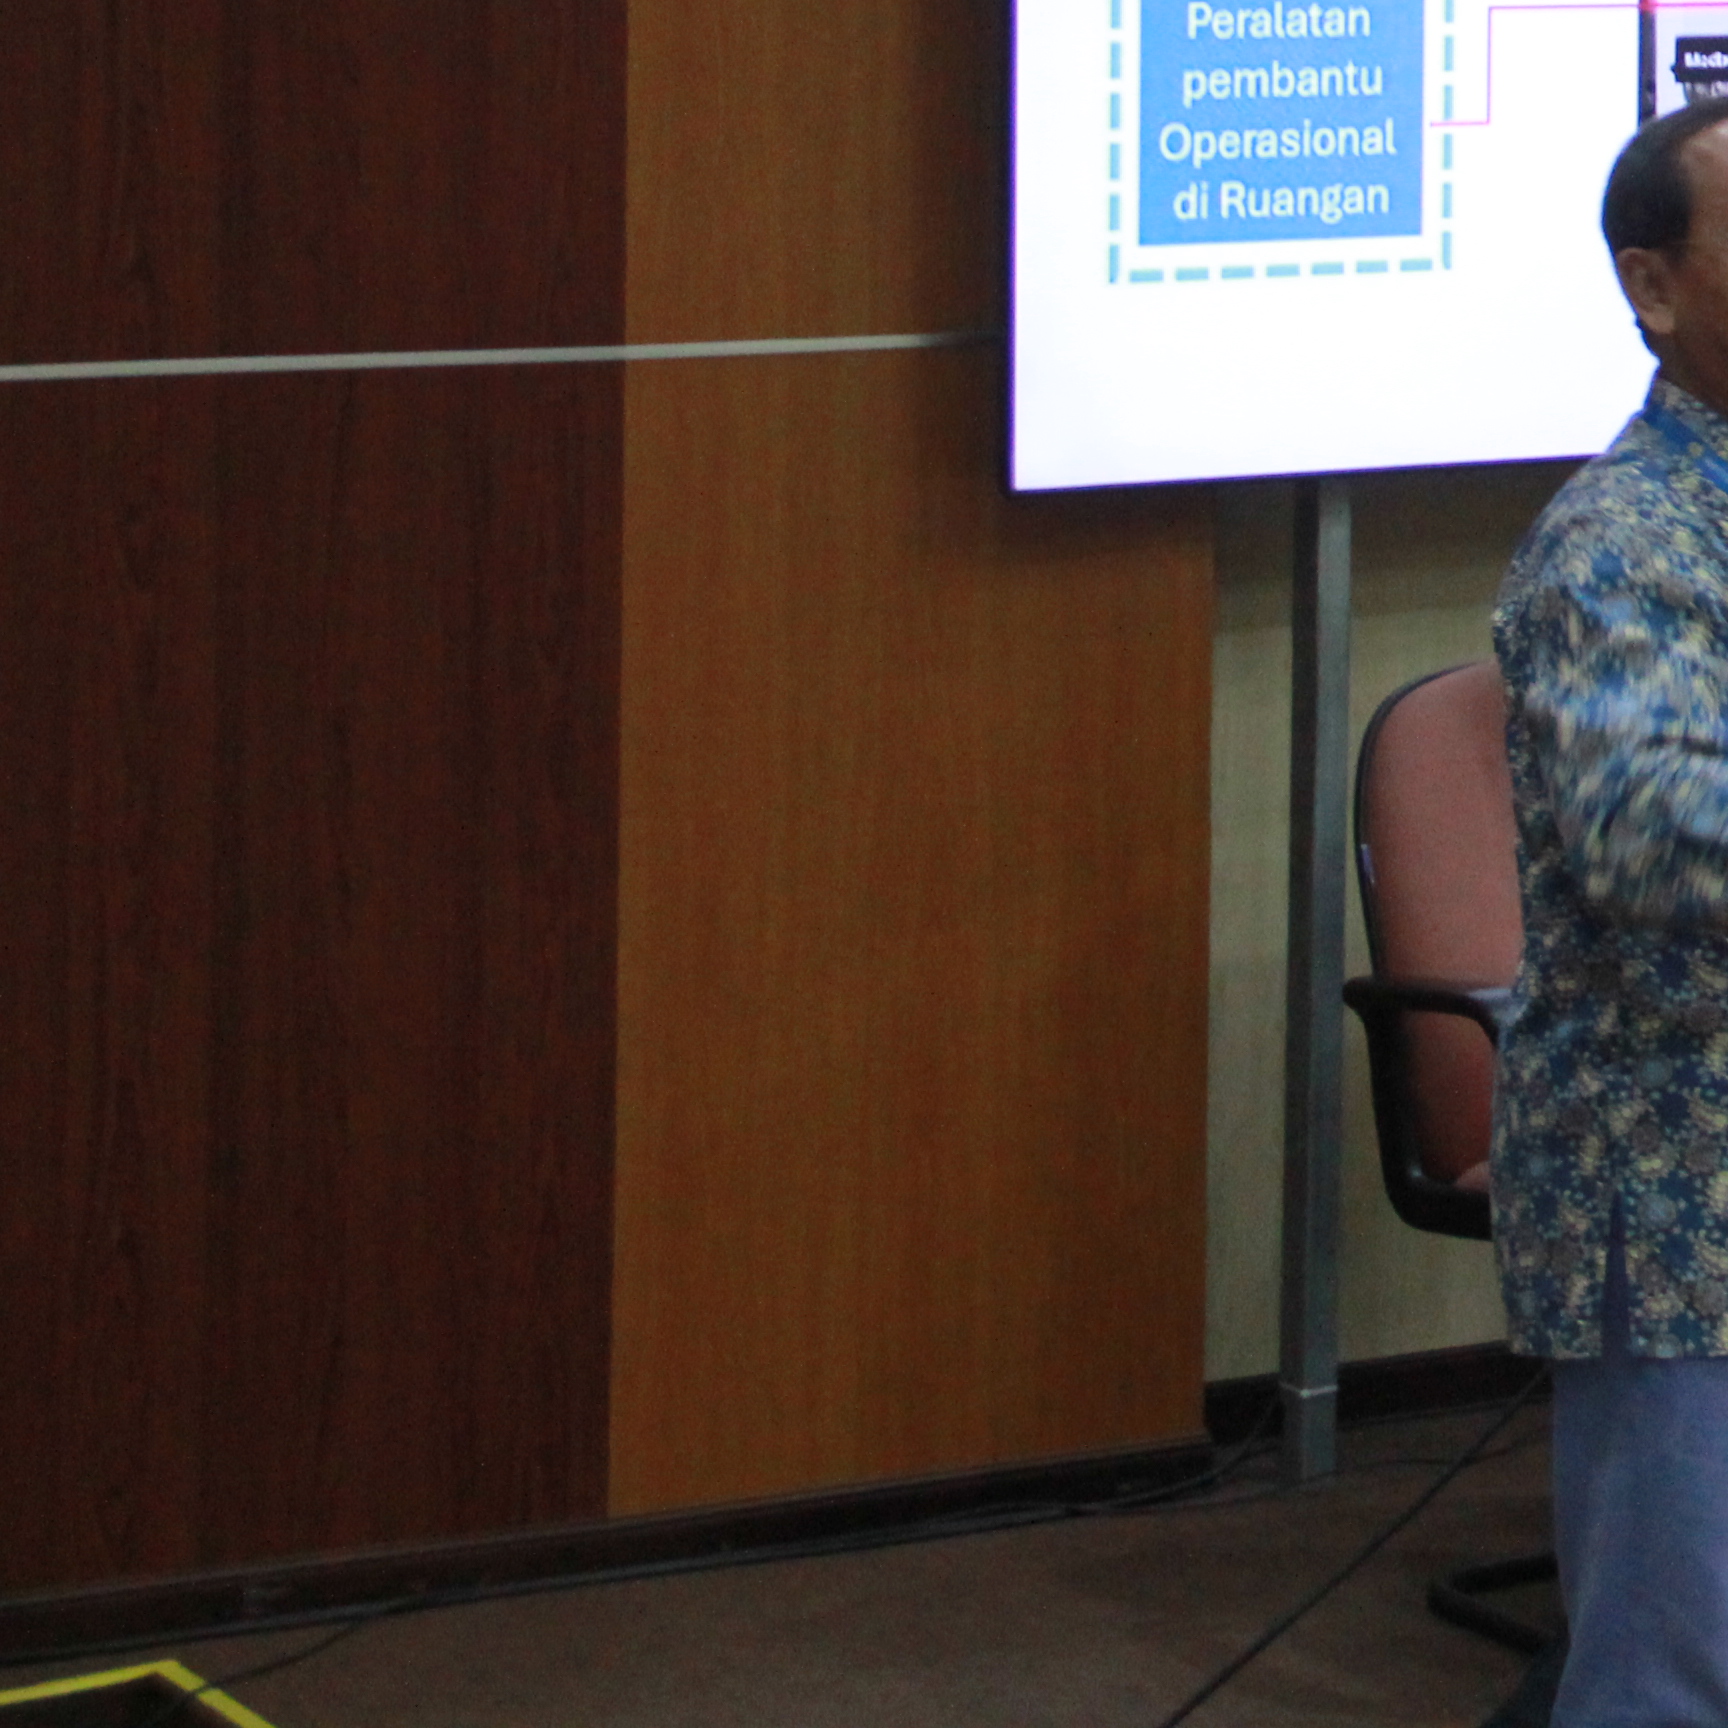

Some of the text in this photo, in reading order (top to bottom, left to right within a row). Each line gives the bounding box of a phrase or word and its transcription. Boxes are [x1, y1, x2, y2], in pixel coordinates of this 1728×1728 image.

[1187, 0, 1370, 39] Peralatan
[1182, 60, 1382, 108] pembantu
[1159, 118, 1397, 169] Operasional
[1173, 180, 1390, 224] di Ruangan
